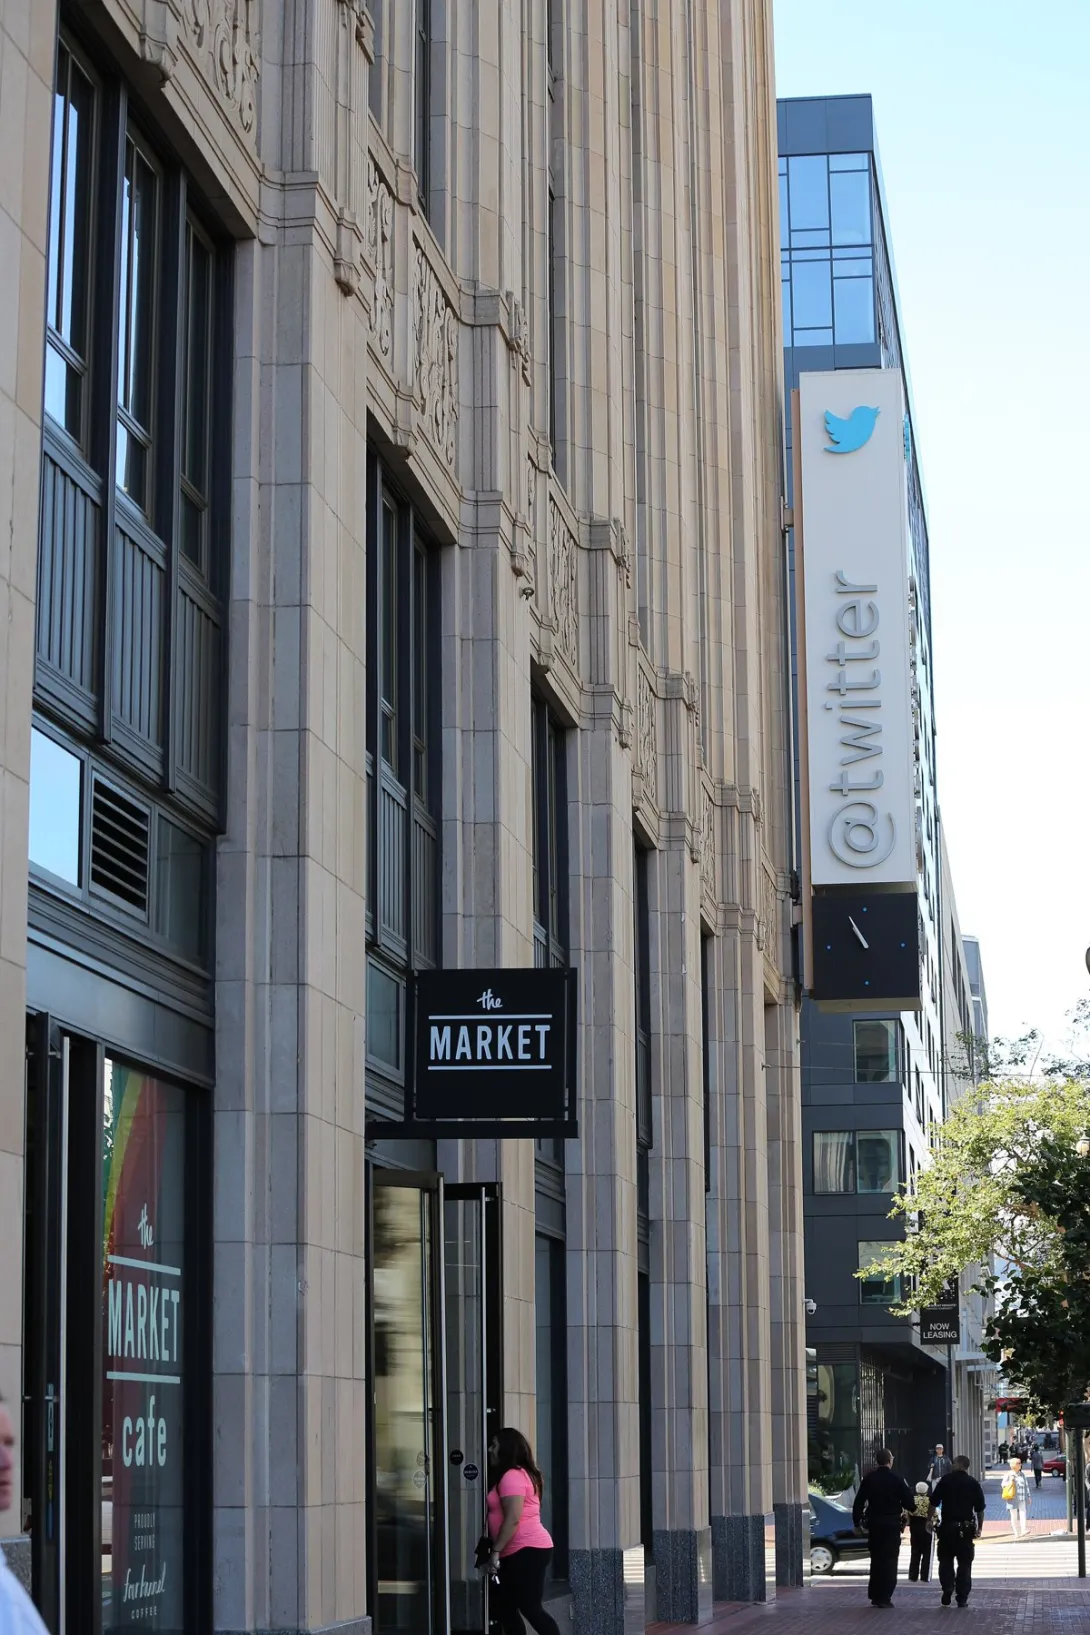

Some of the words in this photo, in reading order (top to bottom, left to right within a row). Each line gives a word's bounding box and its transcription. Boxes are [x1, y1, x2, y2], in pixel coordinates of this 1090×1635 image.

[825, 570, 896, 869] @twitter
[476, 988, 503, 1010] the
[430, 1025, 550, 1060] MARKET
[137, 1203, 154, 1250] the
[108, 1279, 180, 1362] MARKET
[923, 1331, 957, 1339] LEASING
[122, 1395, 167, 1467] cafe
[134, 1512, 156, 1529] PROUDLY
[134, 1534, 156, 1551] SERVING
[131, 1606, 157, 1620] COFFEE
